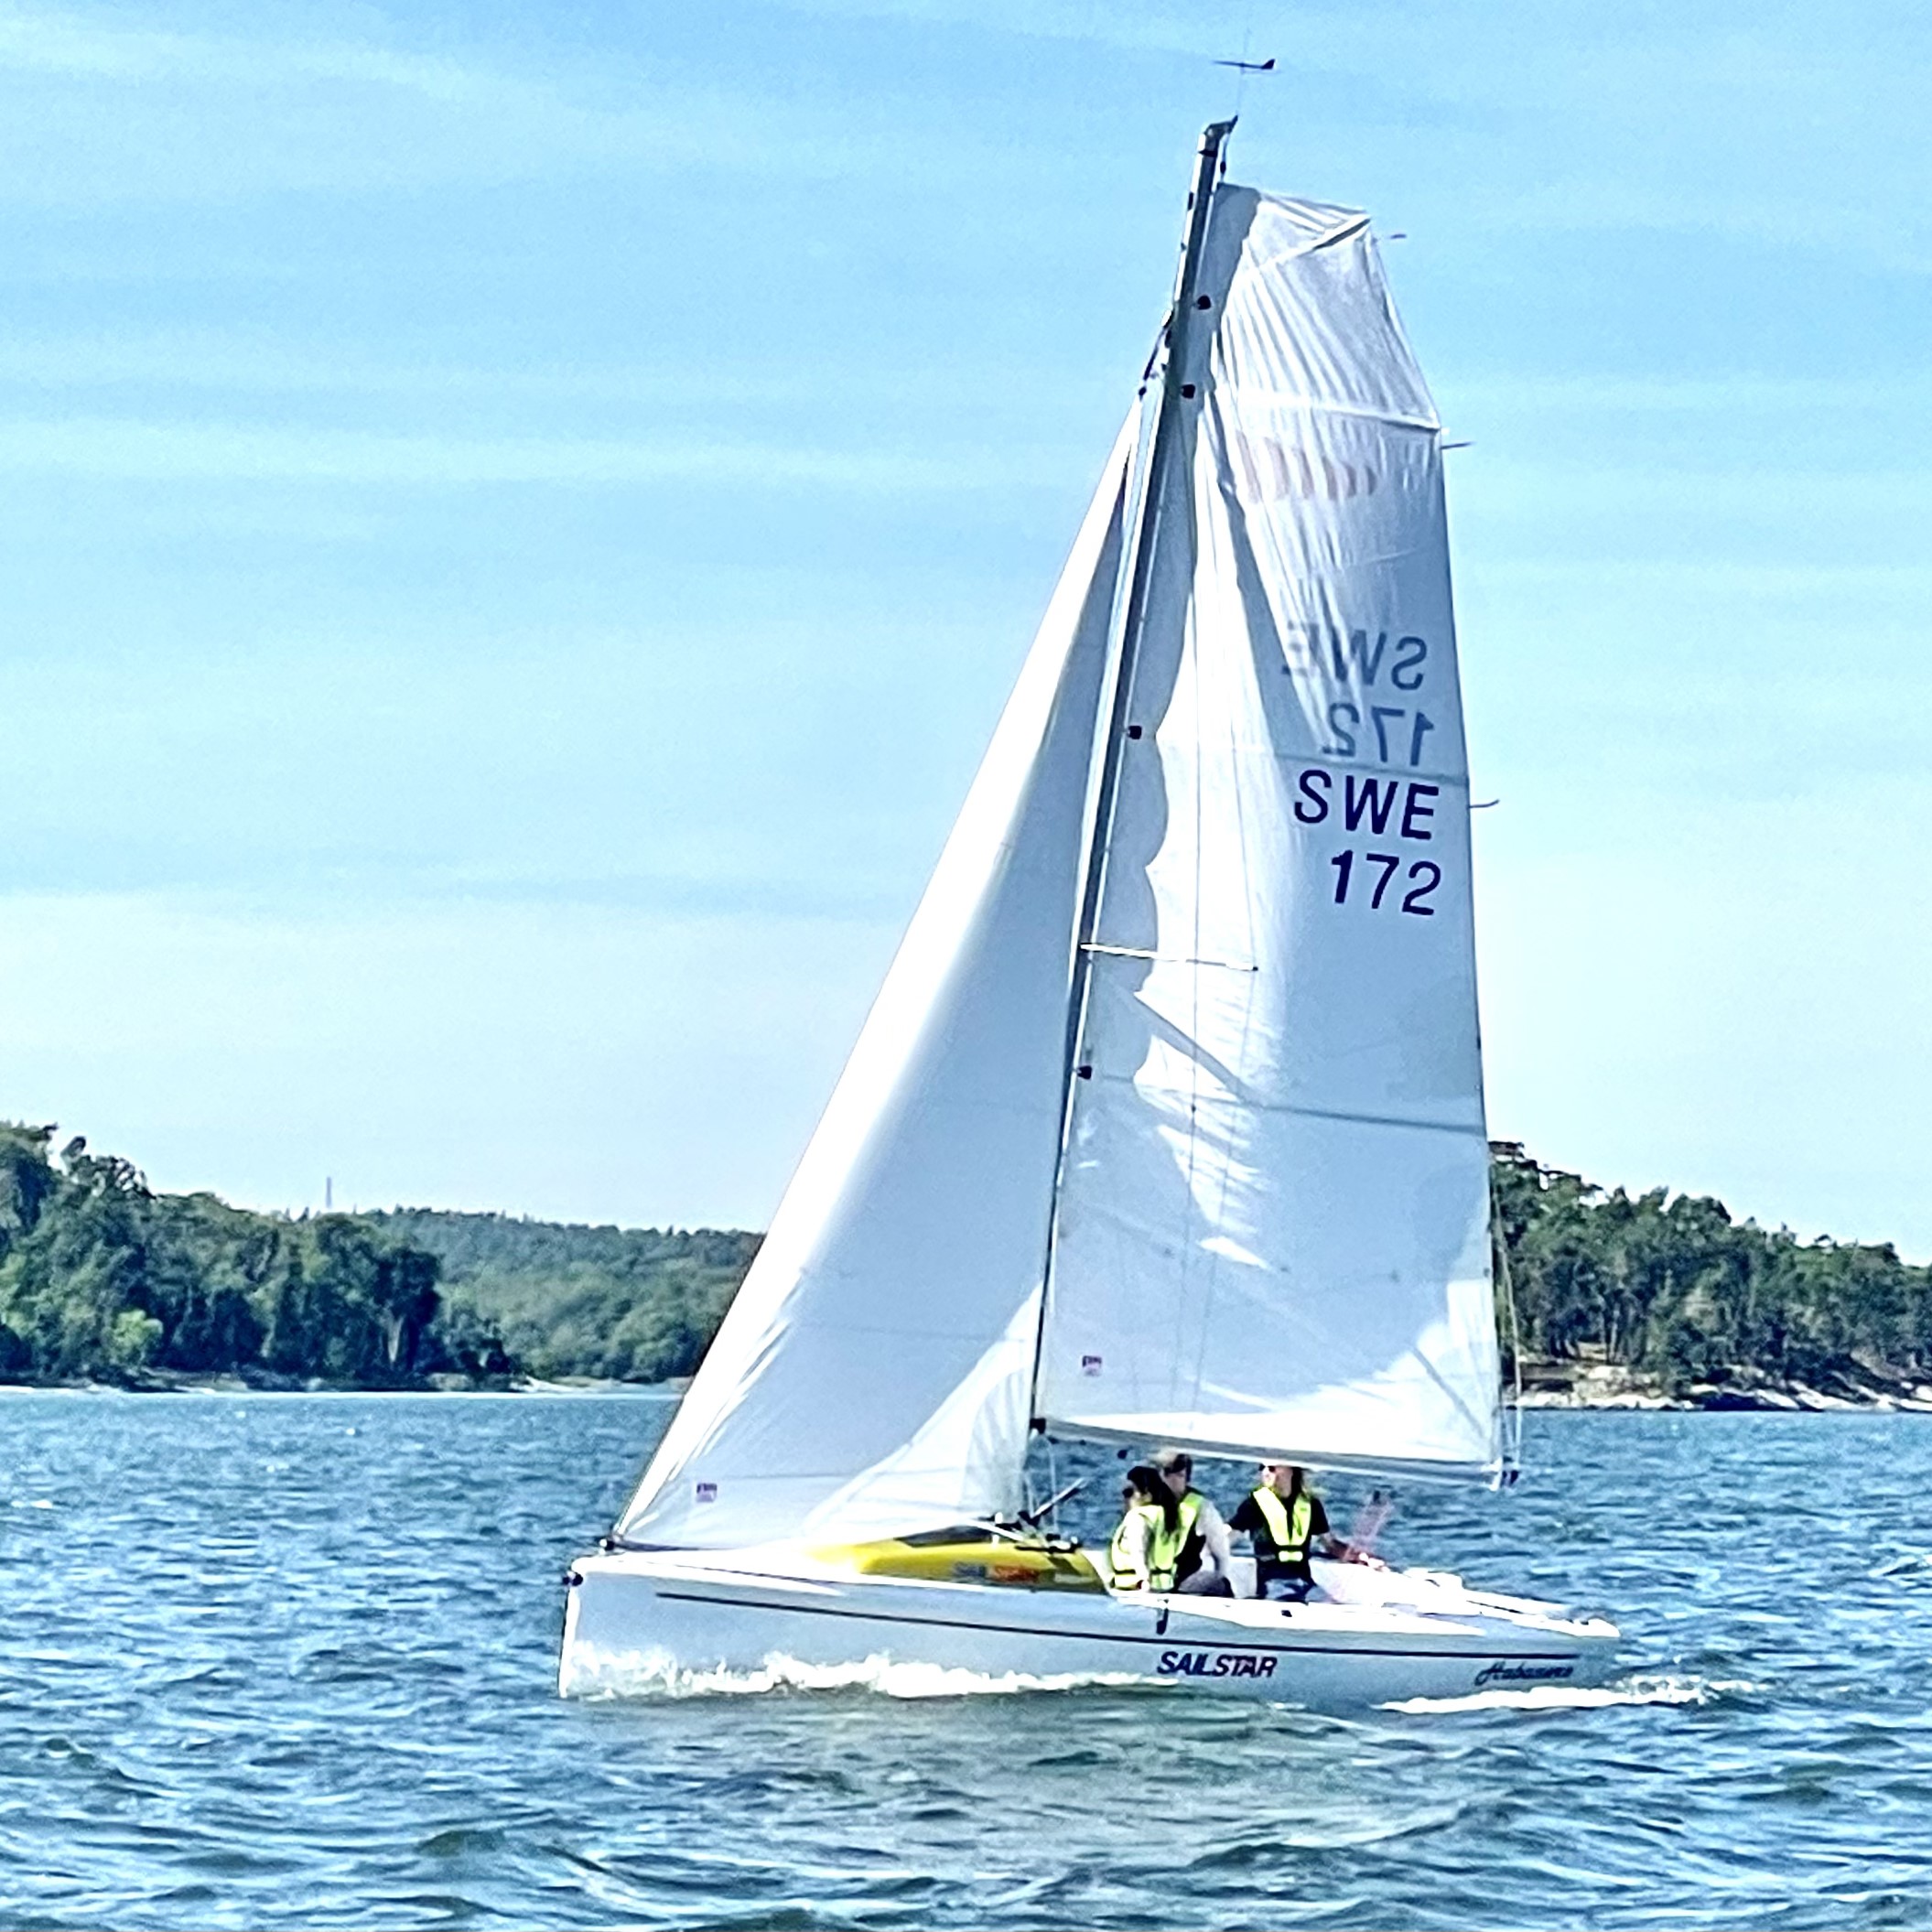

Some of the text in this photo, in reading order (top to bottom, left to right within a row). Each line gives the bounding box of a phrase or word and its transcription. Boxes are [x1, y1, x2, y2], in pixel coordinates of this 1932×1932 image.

[1294, 769, 1440, 841] SWE
[1332, 849, 1442, 916] 172
[1157, 1651, 1278, 1678] SAILSTAR
